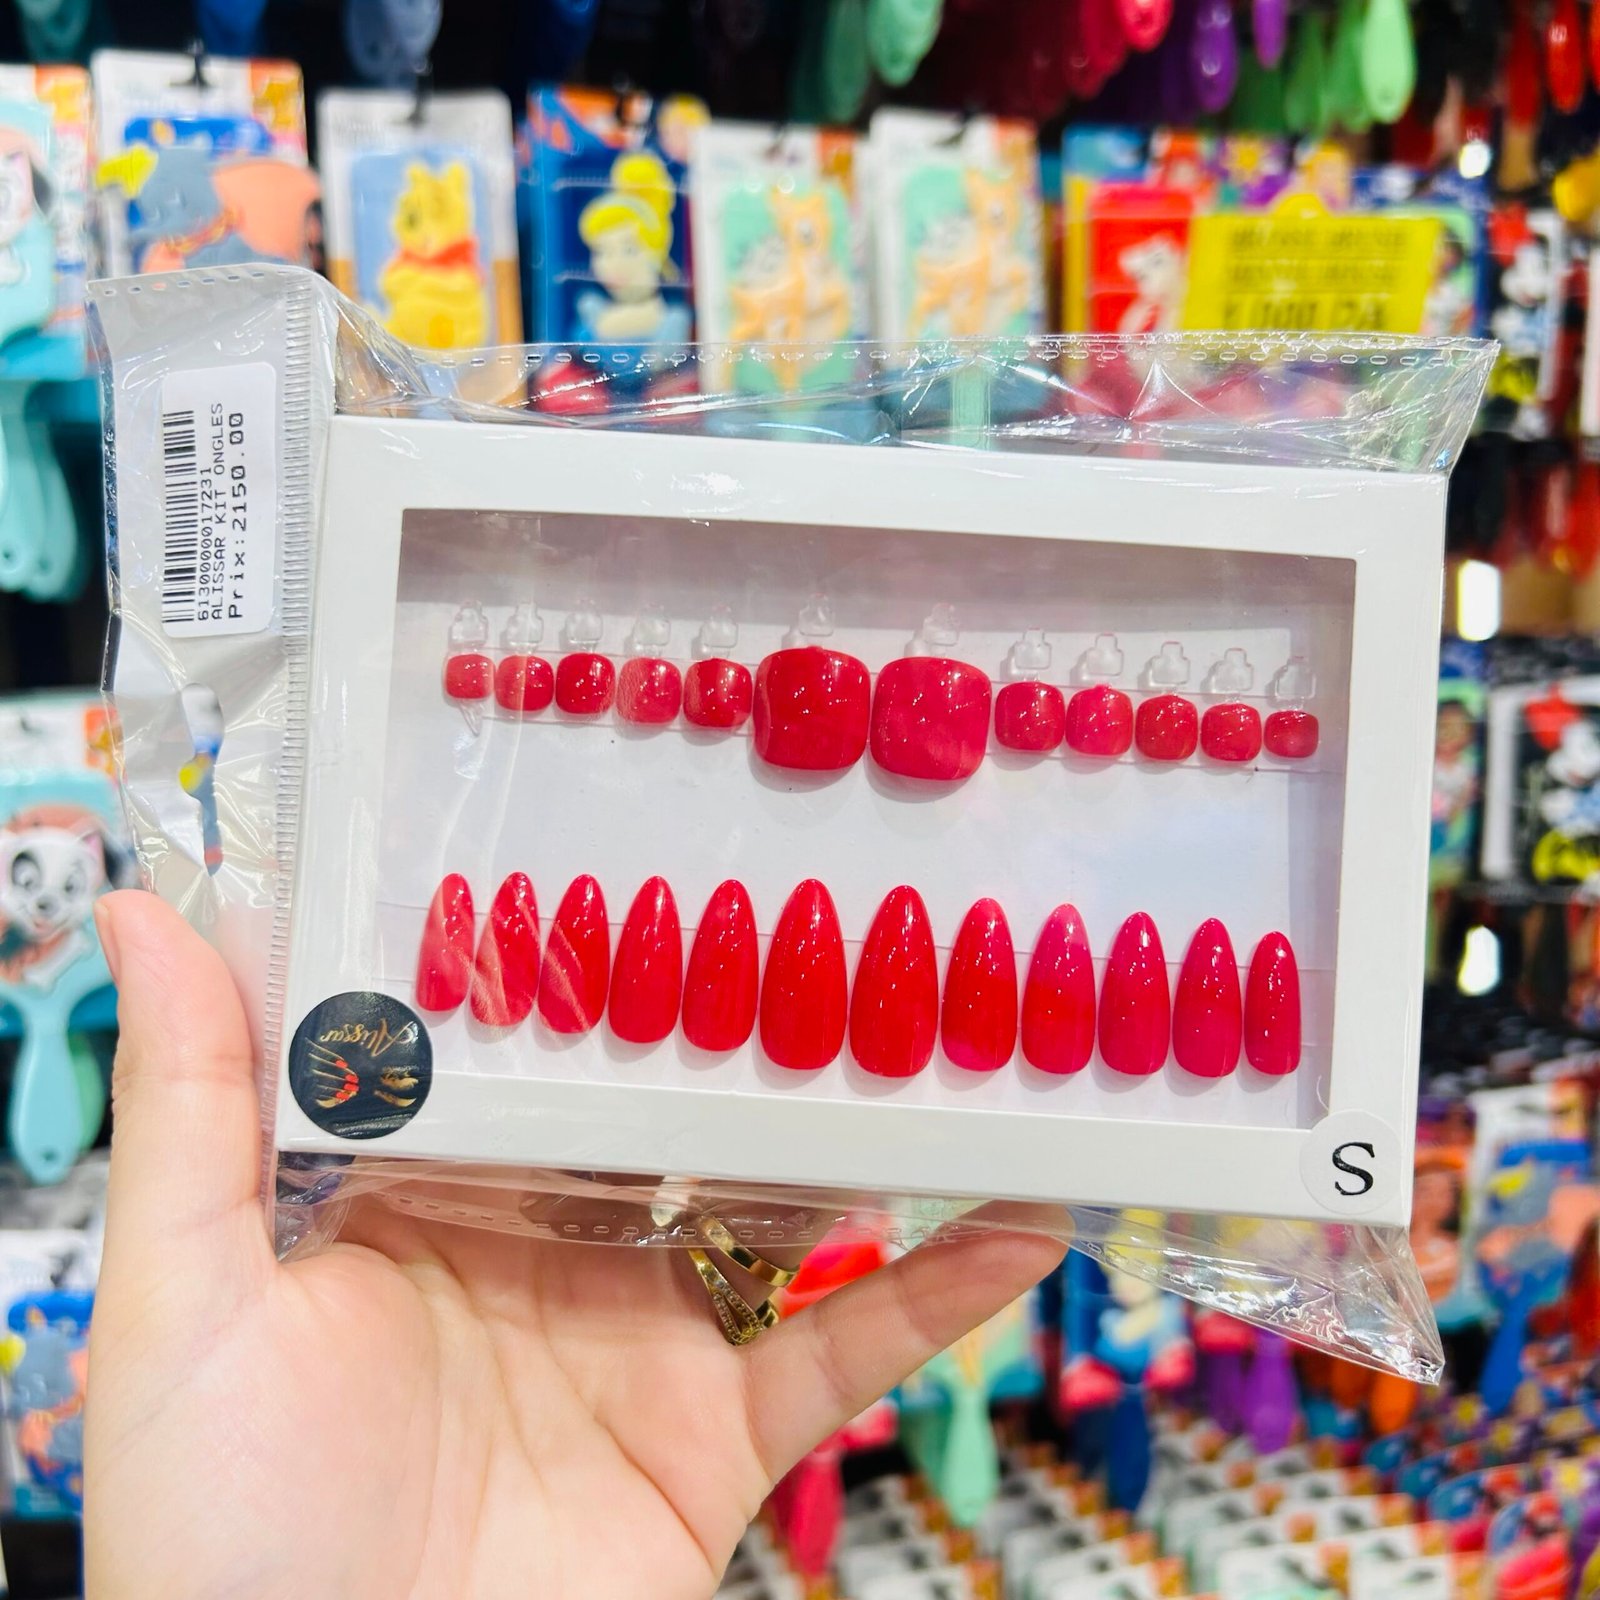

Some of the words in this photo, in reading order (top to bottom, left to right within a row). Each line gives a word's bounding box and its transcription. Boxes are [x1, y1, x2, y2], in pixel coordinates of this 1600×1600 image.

[211, 402, 225, 475] ONGLES
[214, 489, 227, 525] KIT
[198, 467, 213, 621] 6130000017231
[211, 536, 227, 620] ALISSAR
[319, 1018, 419, 1057] Alissar
[1332, 1141, 1375, 1196] S
